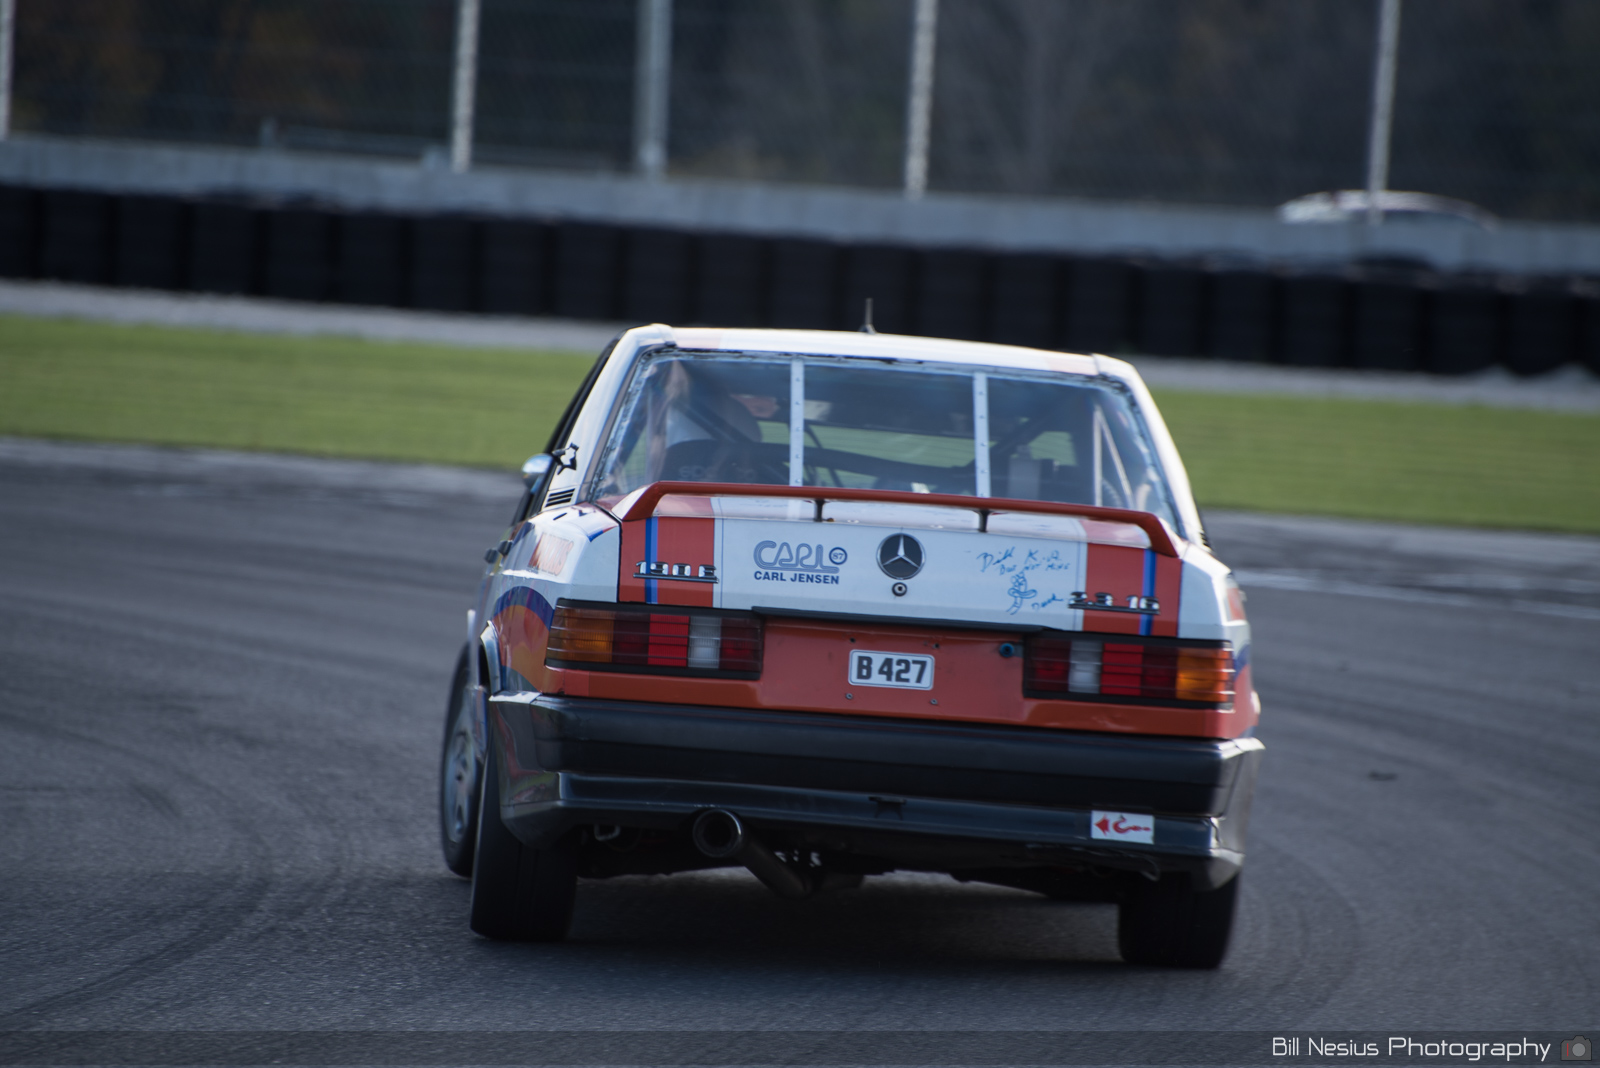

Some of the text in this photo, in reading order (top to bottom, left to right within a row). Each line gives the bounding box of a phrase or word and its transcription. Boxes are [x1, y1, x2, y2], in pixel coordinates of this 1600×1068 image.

[754, 571, 840, 585] CARL JENSEN
[856, 655, 927, 683] B 427
